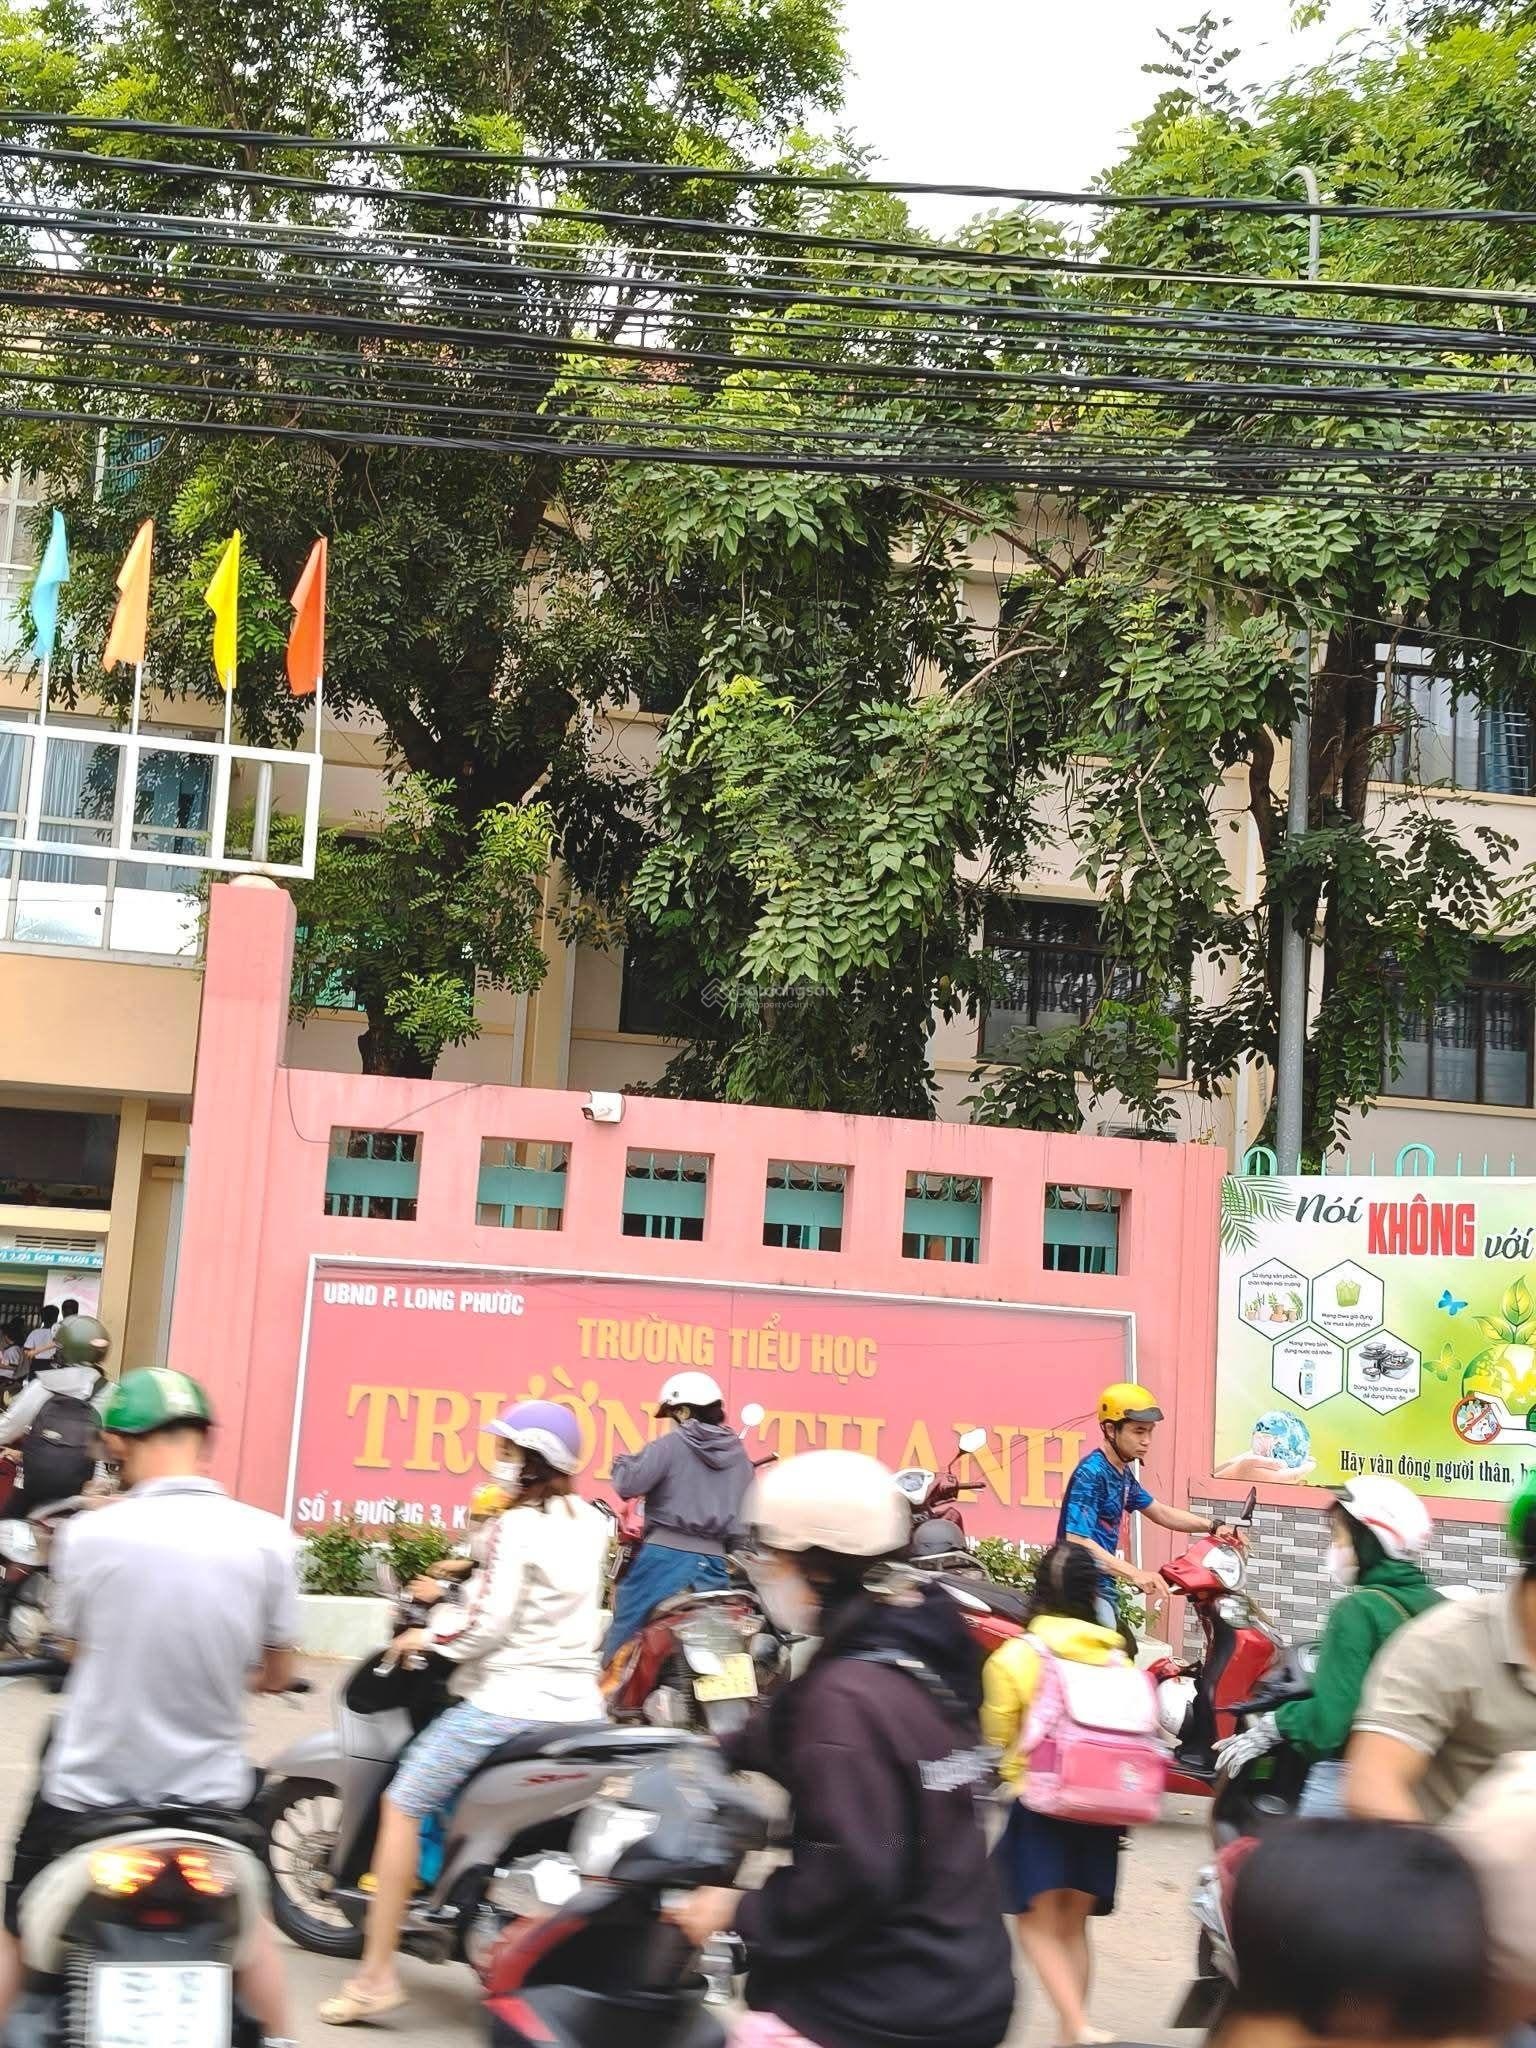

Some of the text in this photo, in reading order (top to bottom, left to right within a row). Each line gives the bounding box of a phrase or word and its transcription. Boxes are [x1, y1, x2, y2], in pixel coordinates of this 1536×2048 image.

[1295, 1193, 1534, 1259] Nói KHÔNG với
[323, 1281, 525, 1316] UBND P. LONG PHƯỚC
[577, 1311, 878, 1385] TRƯỜNG TIỂU HỌC
[1340, 1450, 1365, 1475] Hãy
[1435, 1460, 1474, 1483] người
[1479, 1461, 1514, 1486] thân,
[297, 1490, 329, 1522] SỐ
